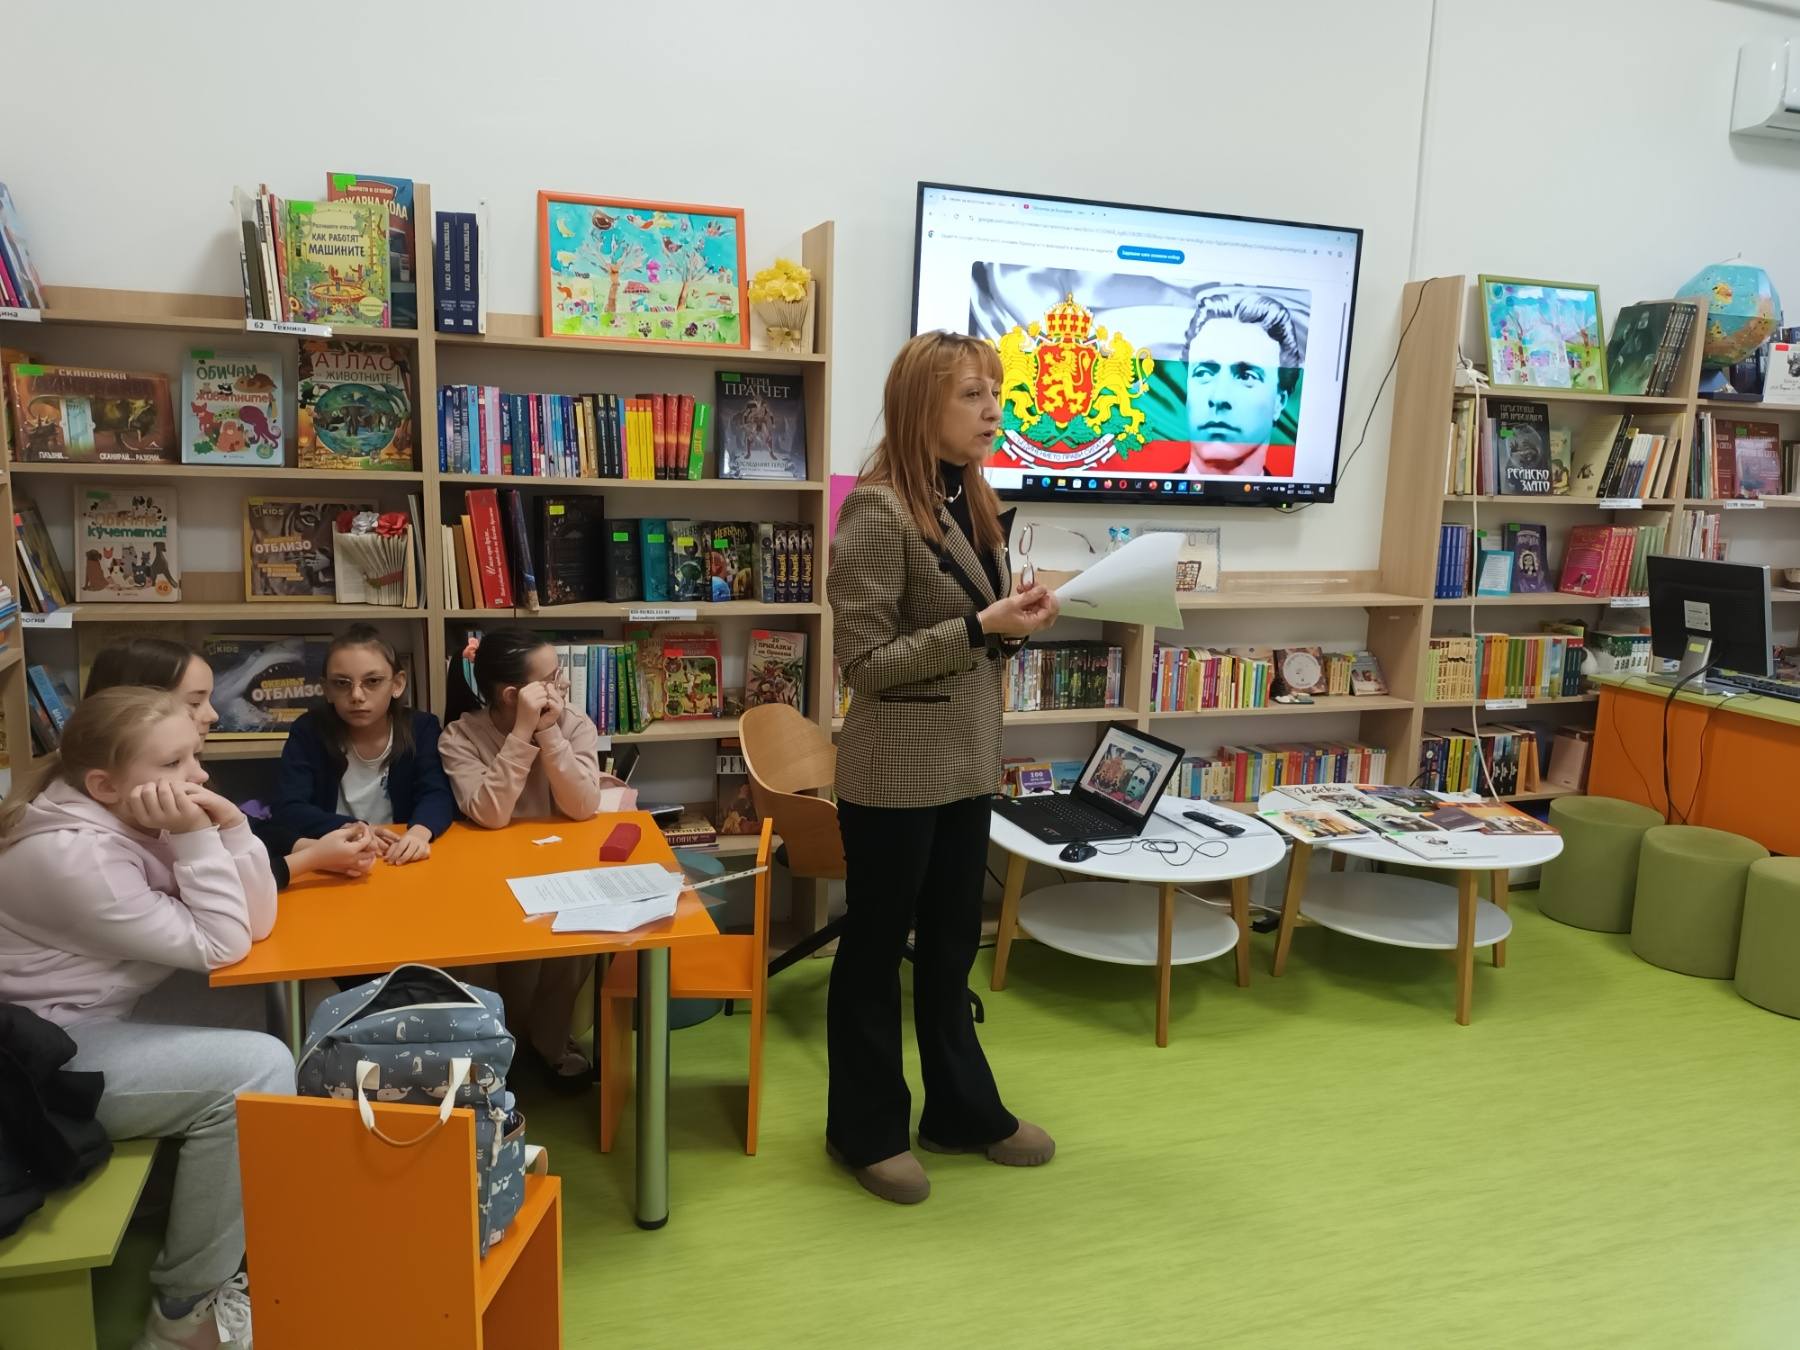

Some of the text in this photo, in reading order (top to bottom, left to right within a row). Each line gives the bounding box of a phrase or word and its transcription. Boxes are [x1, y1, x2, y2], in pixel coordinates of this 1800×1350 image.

[383, 199, 408, 220] КОЛА
[312, 233, 359, 243] КАК РАБОТЯТ
[308, 243, 366, 257] МАШИНИТЕ
[254, 321, 307, 333] 62 Техника
[315, 351, 394, 371] АТЛАС
[58, 368, 127, 380] СКАНОРАМА
[196, 364, 258, 380] ОБИЧАМ
[326, 370, 392, 383] ЖИВОТНИТЕ
[745, 376, 770, 386] ТЕРИ
[725, 383, 792, 398] ПРАТЧЕТ
[1507, 467, 1550, 480] РЕЙНСКО
[1520, 479, 1550, 493] ЗЛАТО
[262, 508, 284, 516] KIDS
[87, 525, 167, 540] кучетата!
[255, 540, 312, 554] ОТБЛИЗО
[251, 684, 324, 702] ОТБЛИЗО
